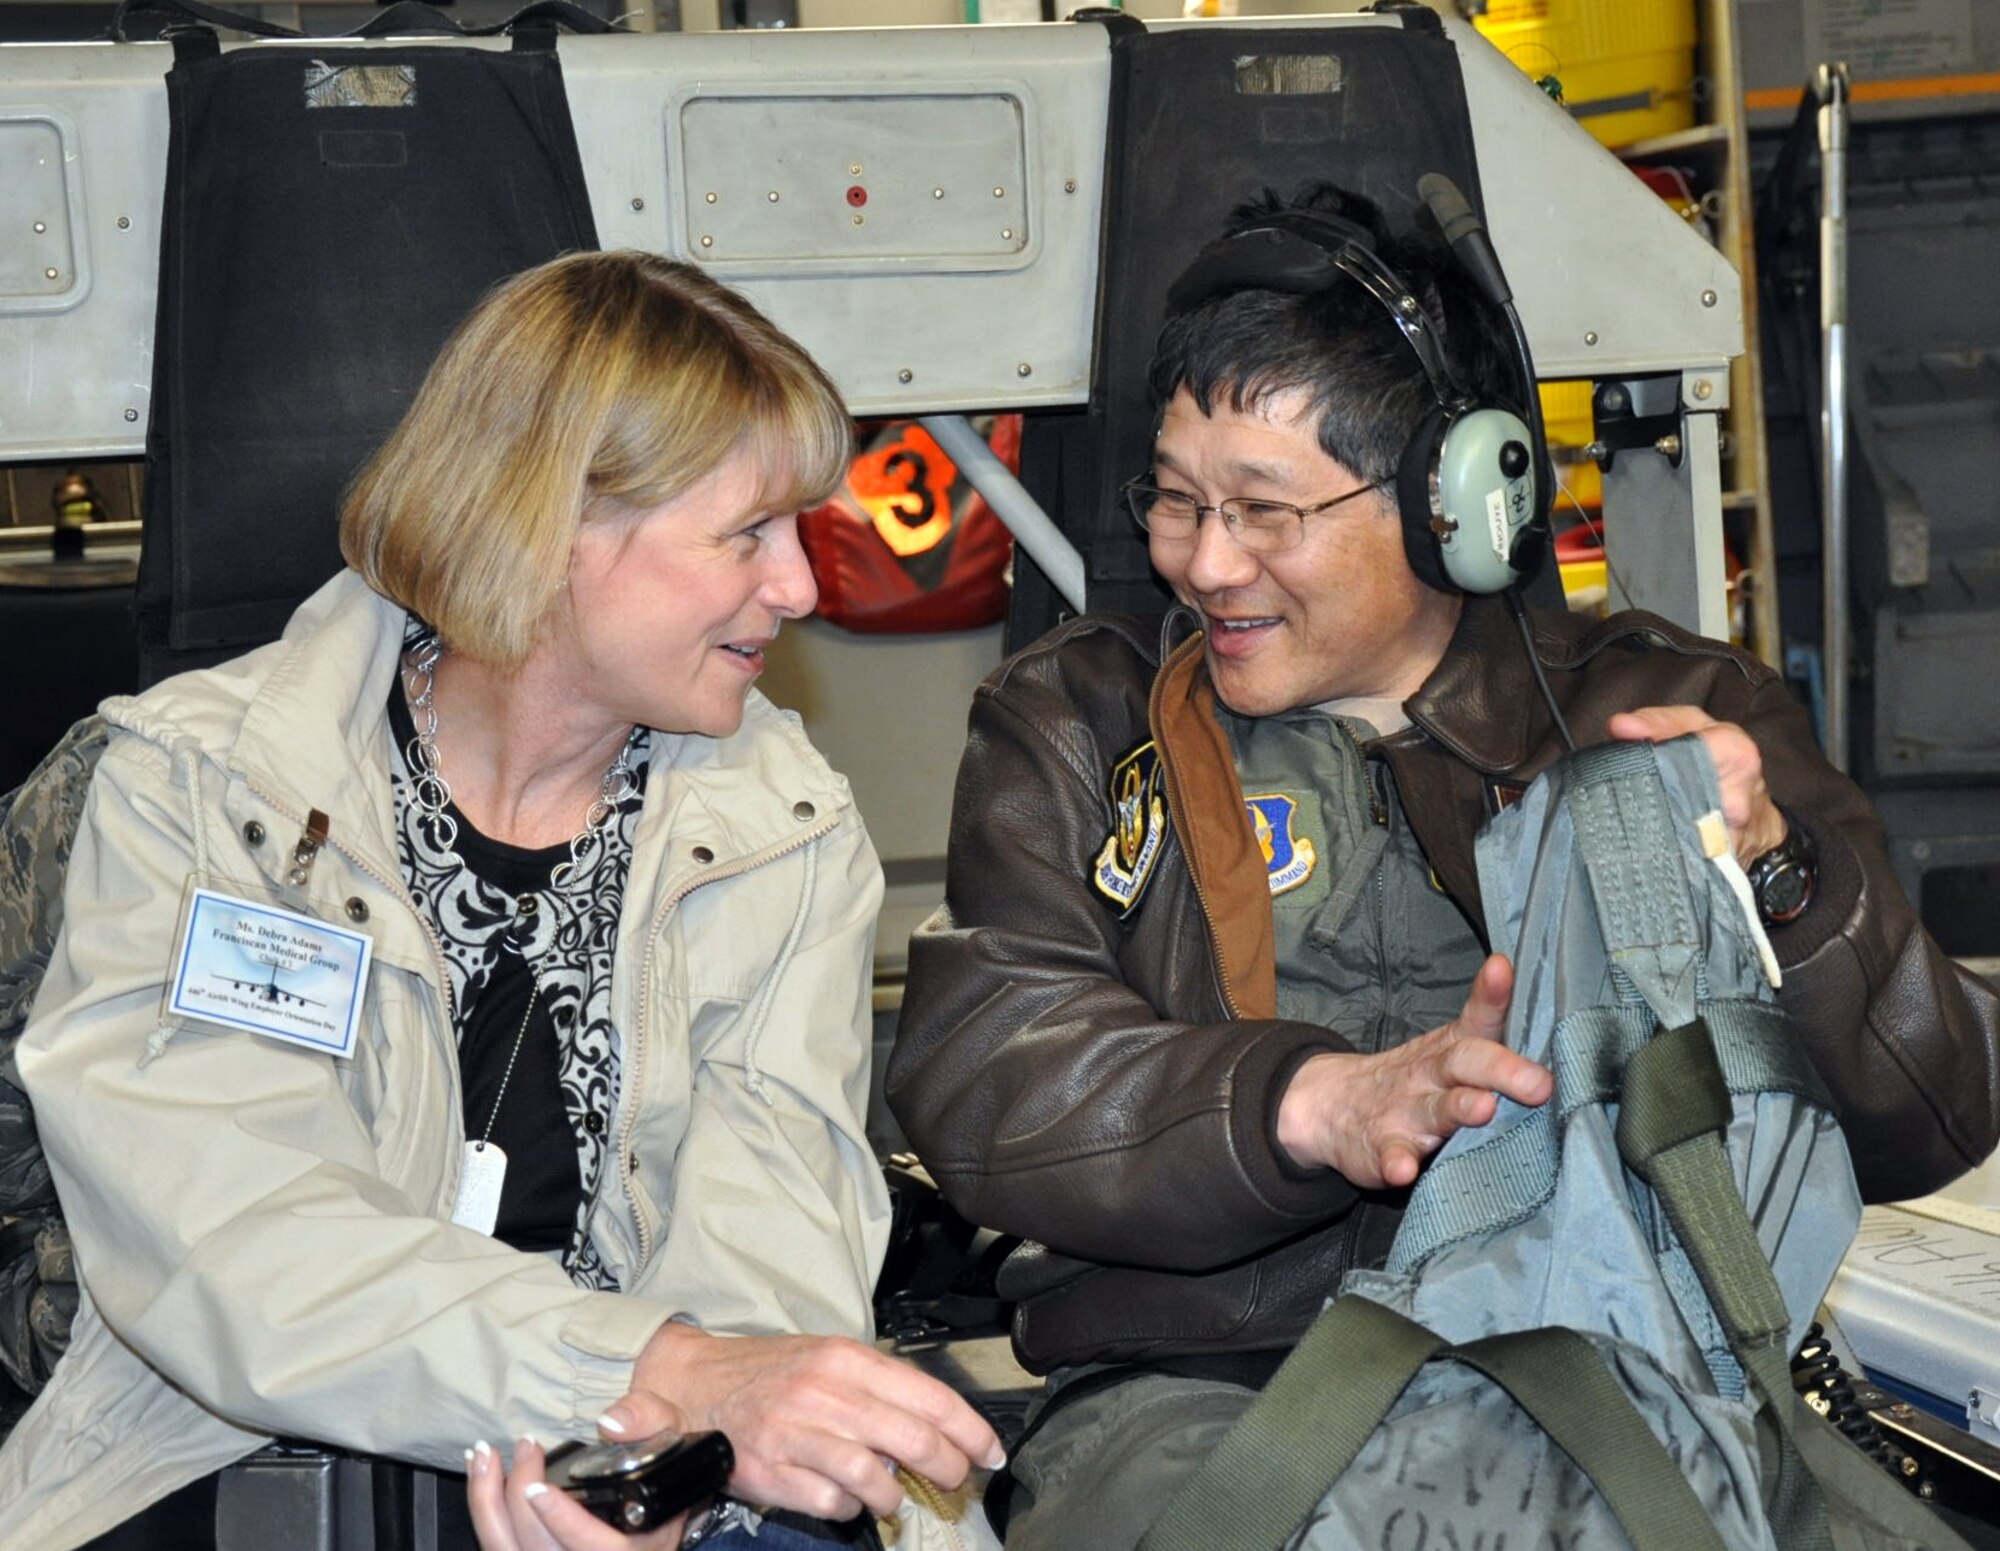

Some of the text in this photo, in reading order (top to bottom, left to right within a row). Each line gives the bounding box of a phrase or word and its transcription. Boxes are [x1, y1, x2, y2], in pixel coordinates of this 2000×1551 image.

[885, 450, 935, 529] 3
[212, 928, 340, 972] Franciscan Medical Group
[237, 920, 323, 953] Ms. Debra Adams
[230, 997, 249, 1009] Wing
[250, 1000, 283, 1015] Employer
[284, 1010, 322, 1027] Orientation
